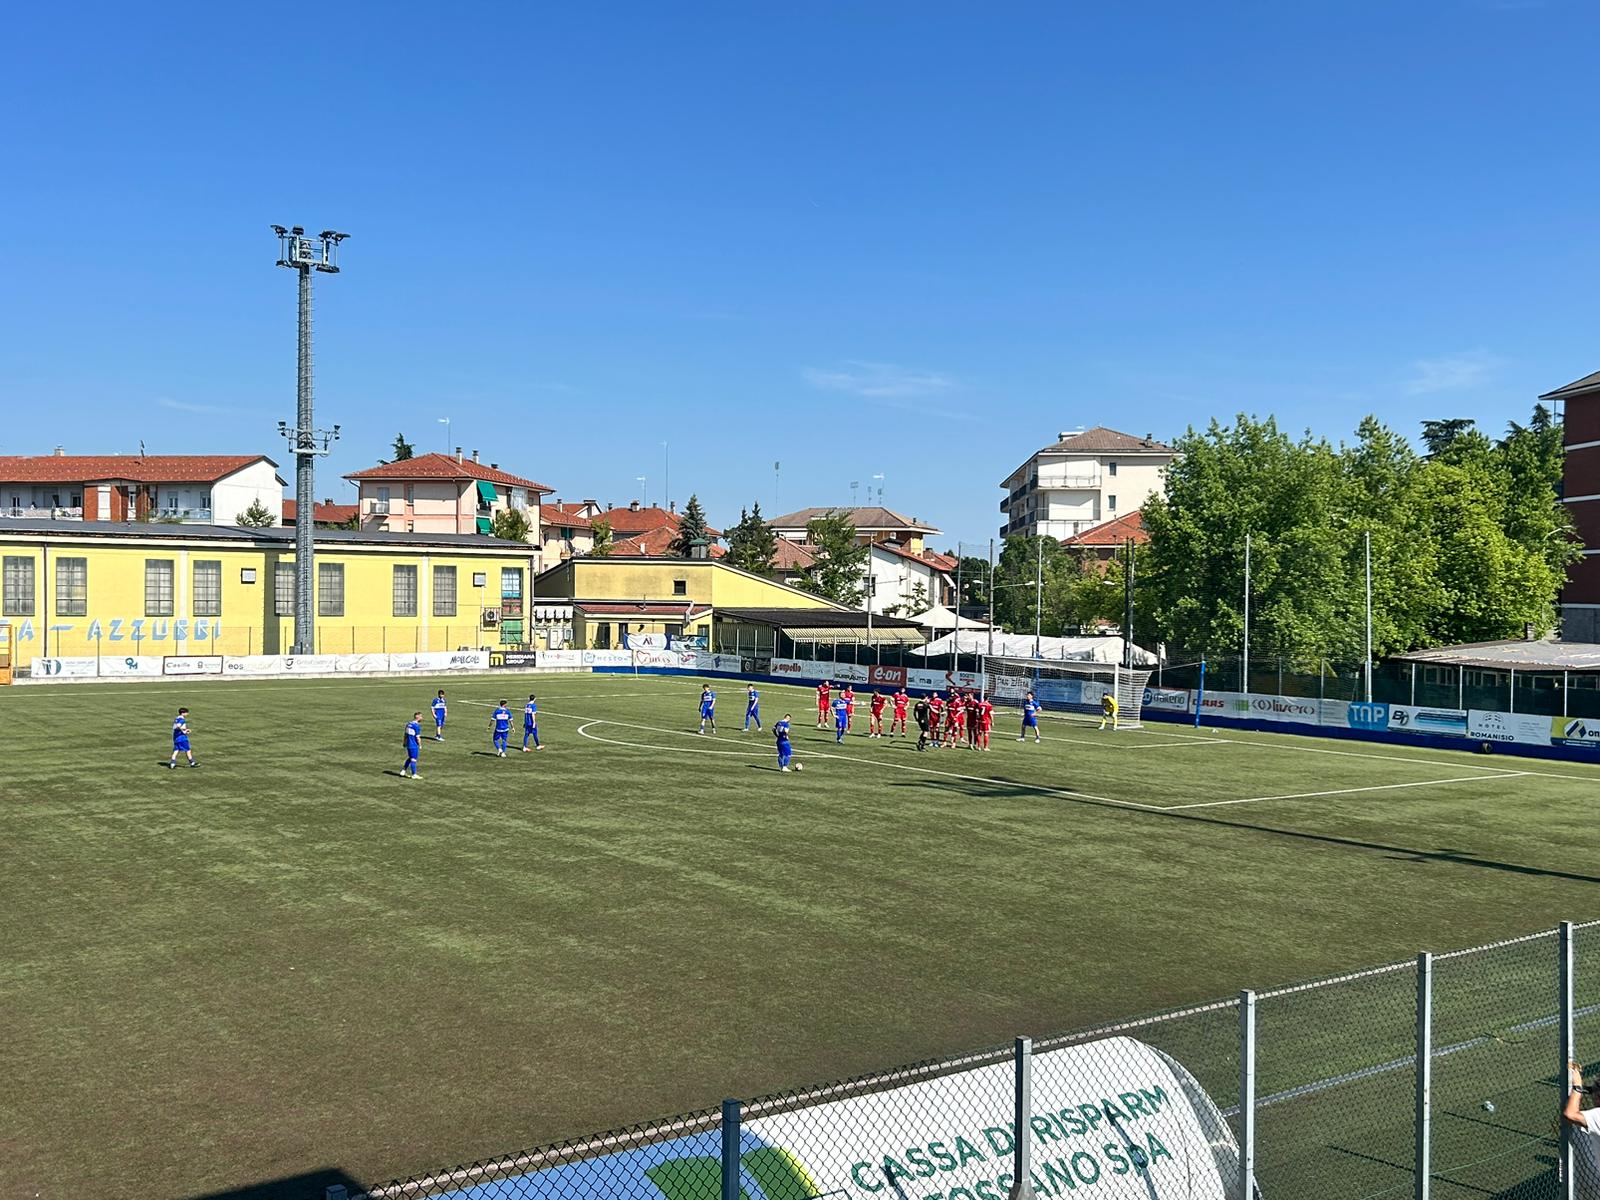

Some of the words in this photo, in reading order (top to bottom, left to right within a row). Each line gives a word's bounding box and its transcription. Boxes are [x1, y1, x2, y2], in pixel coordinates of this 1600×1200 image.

[87, 618, 221, 640] AZZURRI
[1470, 731, 1515, 741] ROMANISIO
[851, 1135, 986, 1193] CASSA
[984, 1121, 1017, 1157] D
[1030, 1084, 1170, 1145] RISPARM
